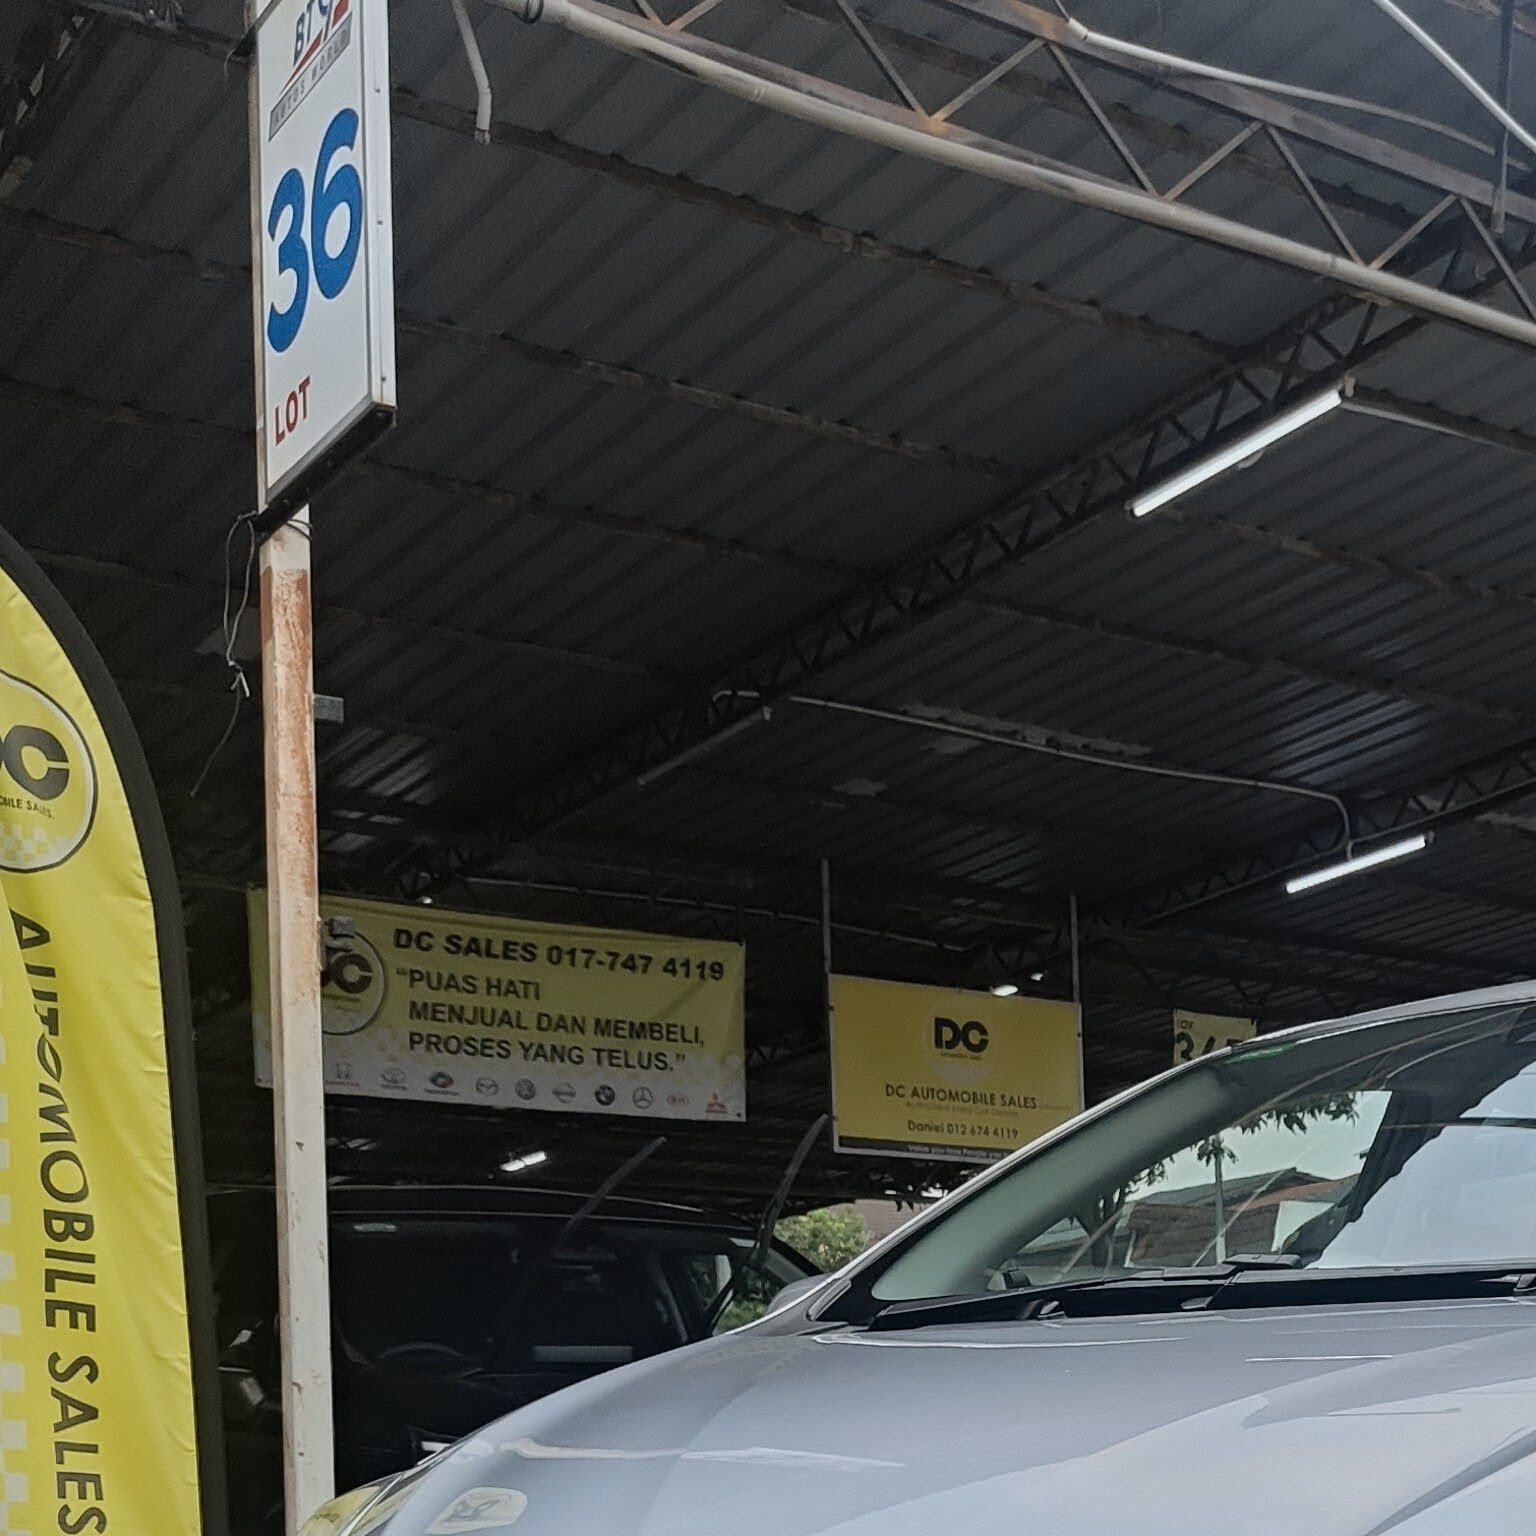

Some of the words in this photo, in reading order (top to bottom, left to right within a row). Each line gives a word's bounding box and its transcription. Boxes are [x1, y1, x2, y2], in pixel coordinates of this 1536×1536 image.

[267, 107, 363, 353] 36
[274, 375, 311, 446] LOT
[393, 928, 434, 952] DC
[443, 934, 538, 963] SALES
[546, 945, 653, 975] 017-747
[662, 957, 724, 981] 4119
[485, 976, 541, 1001] HATI
[408, 1000, 530, 1031] MENJUAL
[536, 1012, 586, 1036] DAN
[934, 1016, 990, 1053] DC
[408, 1031, 512, 1060] PROSES
[518, 1041, 585, 1066] YANG
[885, 1082, 907, 1099] DC
[911, 1085, 997, 1107] AUTOMOBILE
[1000, 1094, 1038, 1110] SALES
[907, 1119, 945, 1133] Daniel
[946, 1122, 967, 1136] 012
[47, 1351, 107, 1535] SALES
